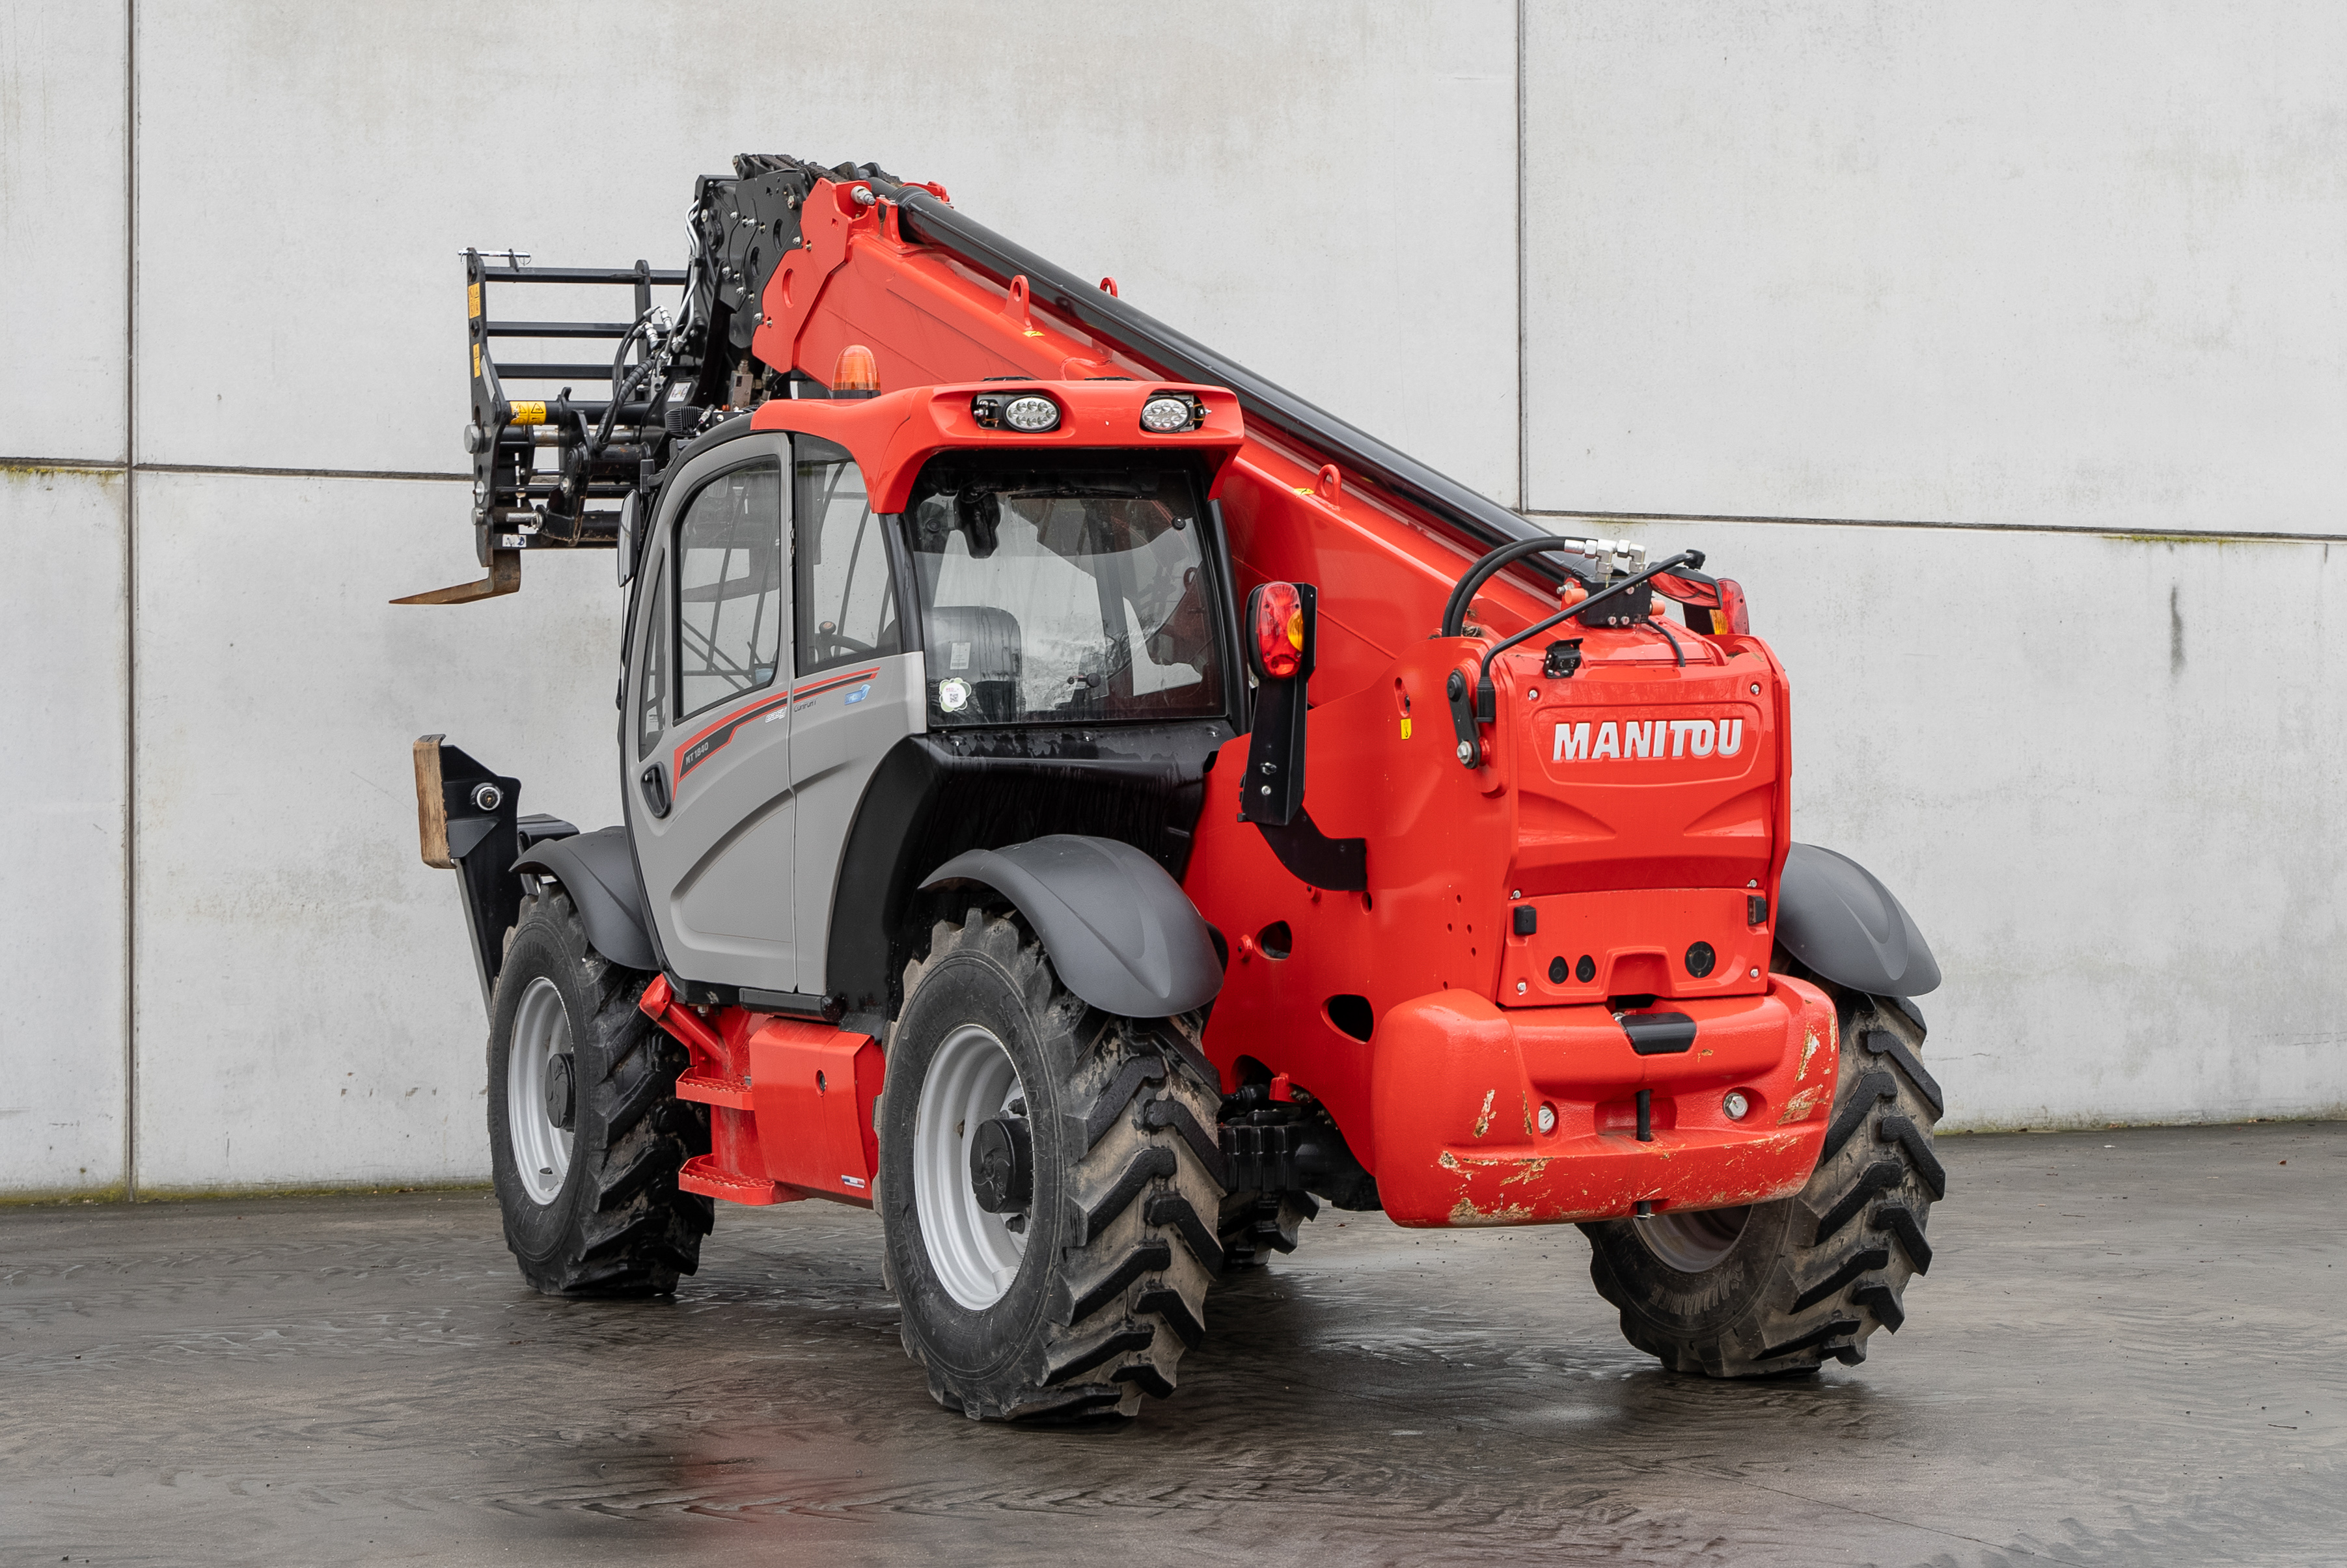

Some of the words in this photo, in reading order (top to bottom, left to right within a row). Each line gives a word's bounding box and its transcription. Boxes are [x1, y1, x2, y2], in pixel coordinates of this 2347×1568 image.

[685, 752, 694, 765] MT
[694, 742, 709, 758] 1840
[1552, 719, 1744, 761] MANITOU
[1648, 1269, 1731, 1316] ALLIANCE
